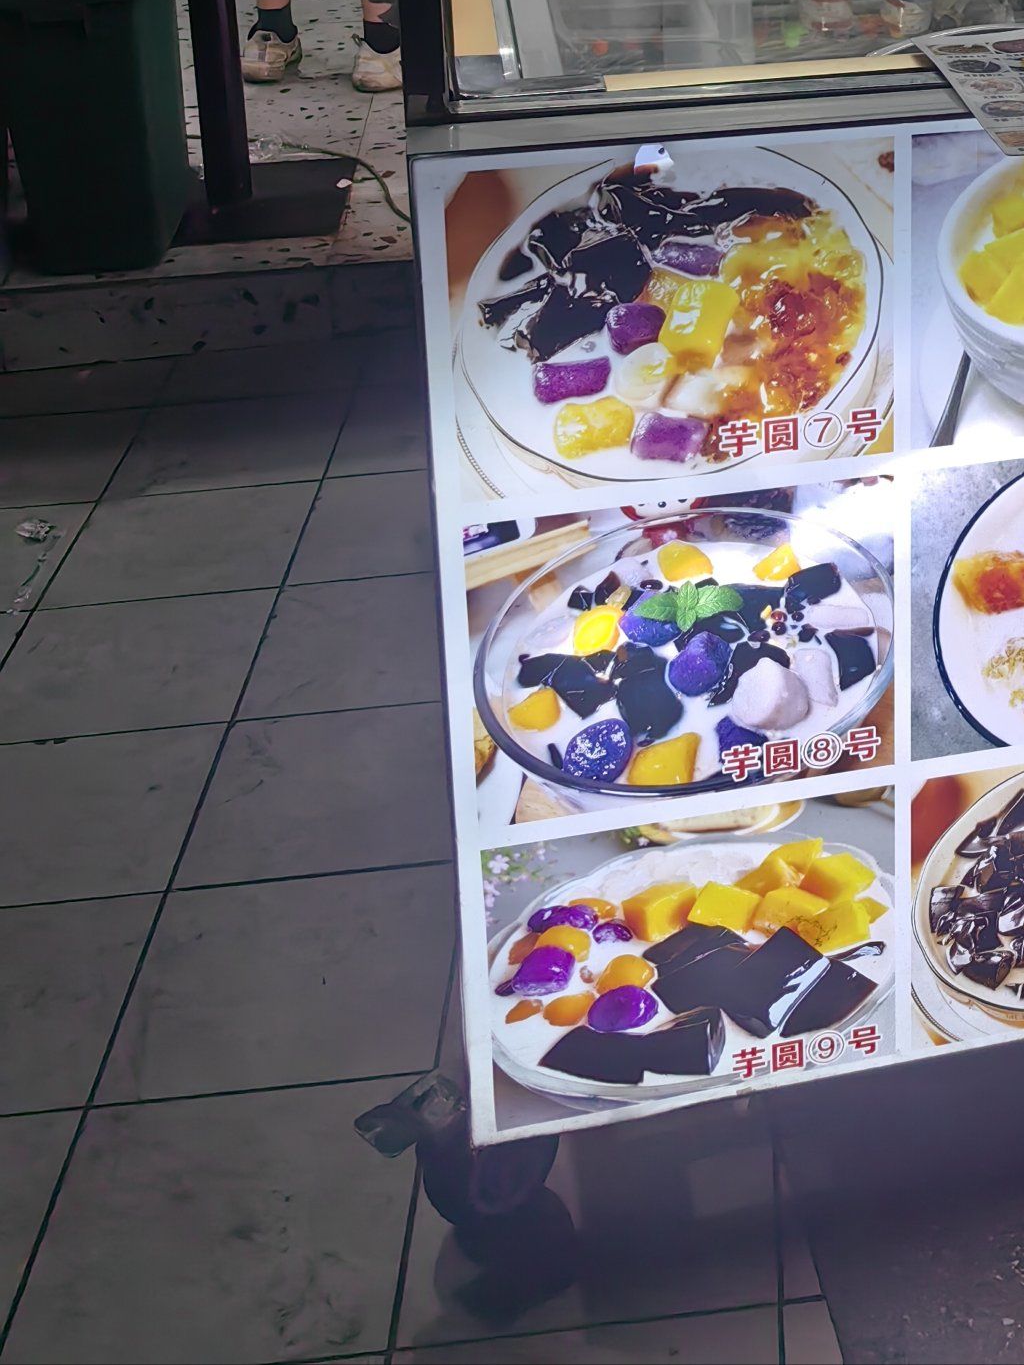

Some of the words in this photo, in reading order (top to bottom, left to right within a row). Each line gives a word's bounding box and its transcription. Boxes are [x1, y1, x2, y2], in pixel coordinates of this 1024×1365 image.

[718, 407, 884, 460] 芋圆⑦号
[721, 725, 882, 781] 芋圆⑧号
[731, 1024, 883, 1079] 芋圆⑨号
